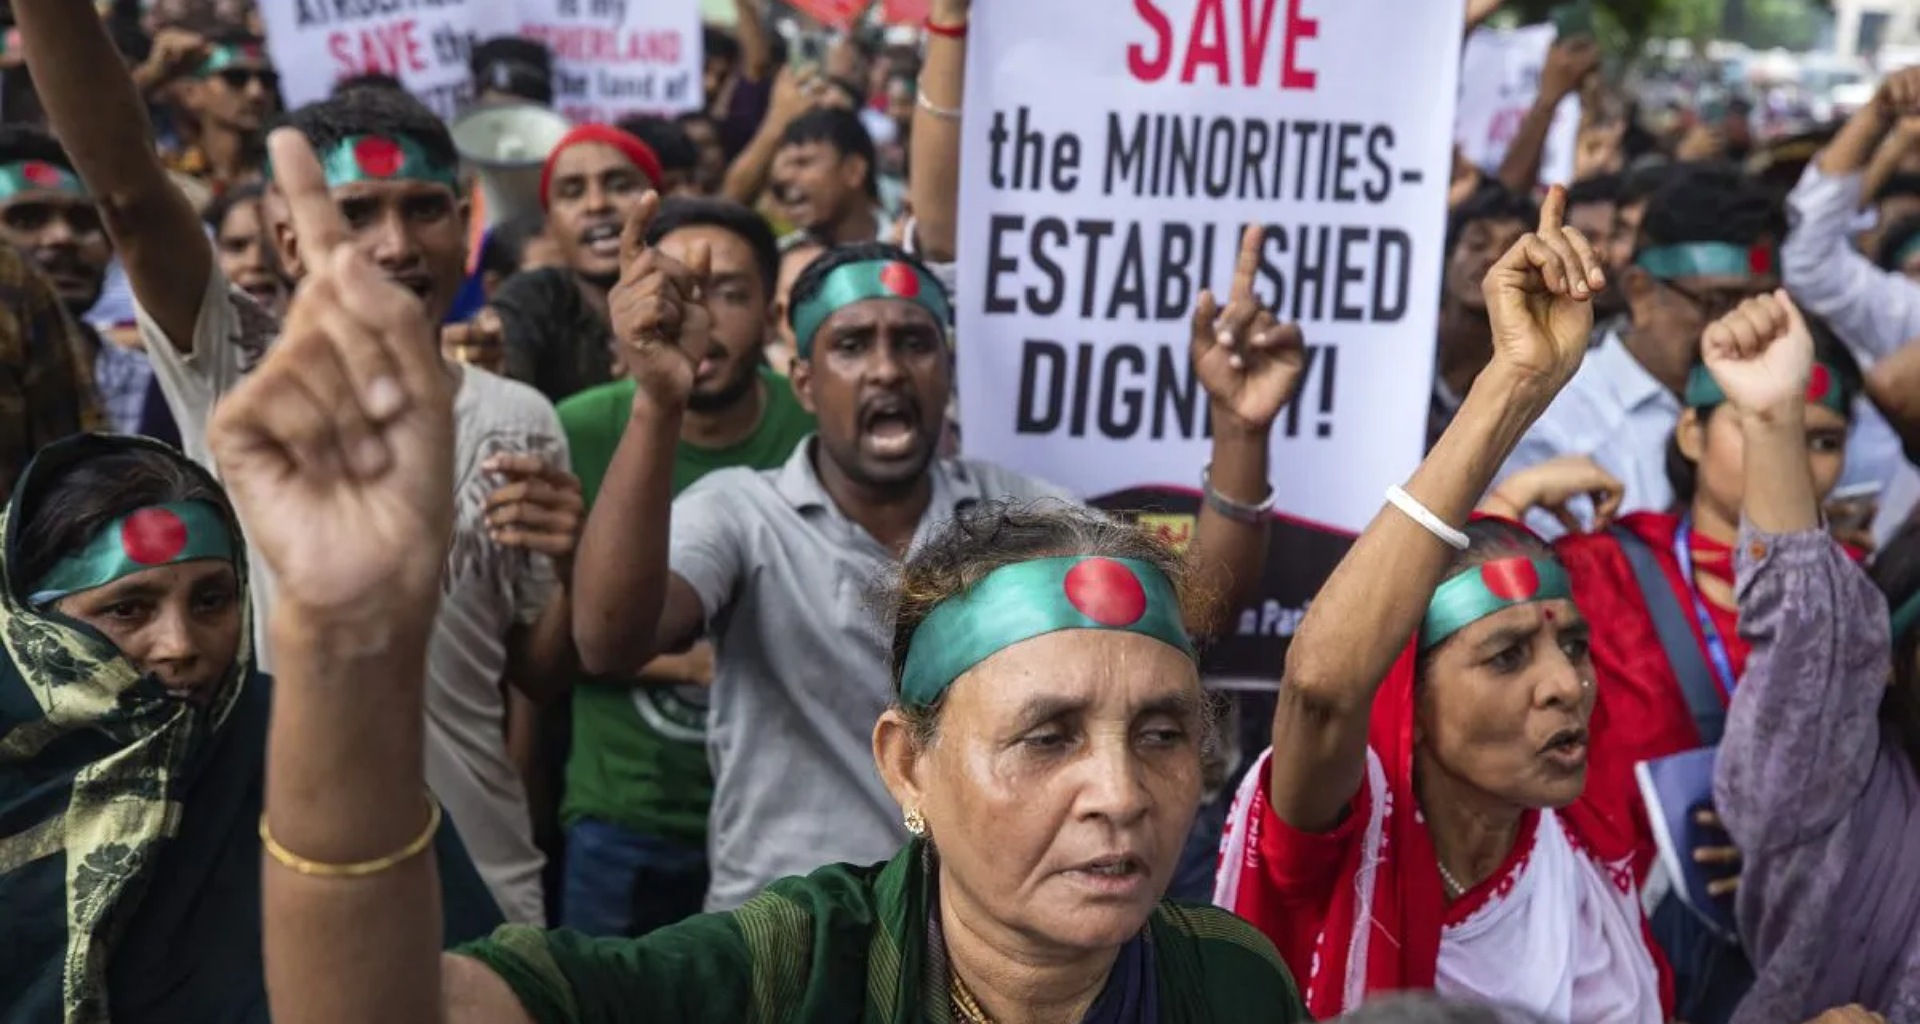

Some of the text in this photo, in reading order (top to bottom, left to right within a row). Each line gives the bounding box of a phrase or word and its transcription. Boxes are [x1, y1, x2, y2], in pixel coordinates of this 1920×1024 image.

[328, 19, 426, 80] SAVE
[1126, 0, 1319, 90] SAVE
[988, 106, 1423, 203] the MINORITIES-
[983, 214, 1412, 323] ESTABLSHED
[1016, 339, 1337, 439] DIGNY!
